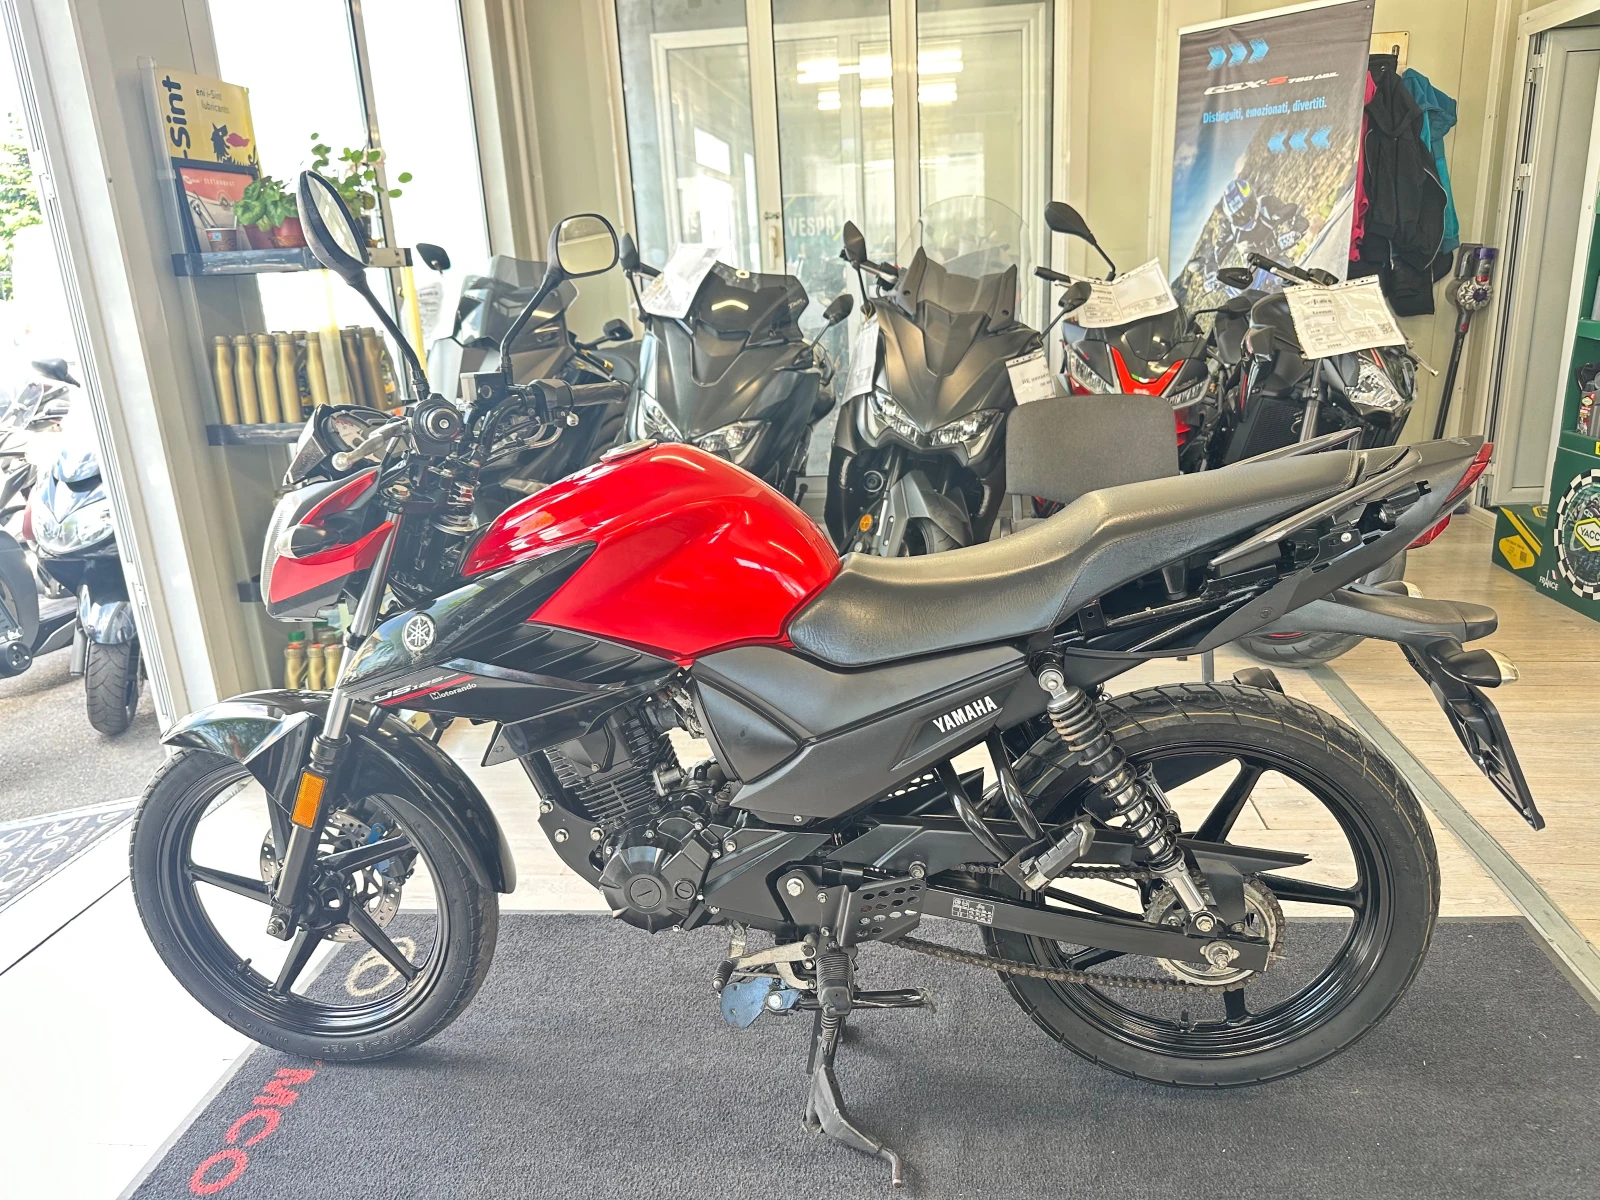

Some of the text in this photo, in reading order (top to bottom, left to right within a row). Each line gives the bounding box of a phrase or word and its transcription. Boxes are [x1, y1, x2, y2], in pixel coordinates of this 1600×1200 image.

[1202, 96, 1328, 124] Distinguiti, emozionati, divertiti.
[1538, 573, 1559, 590] FRANCE
[430, 683, 478, 701] Motorando
[932, 695, 998, 733] YAMAHA
